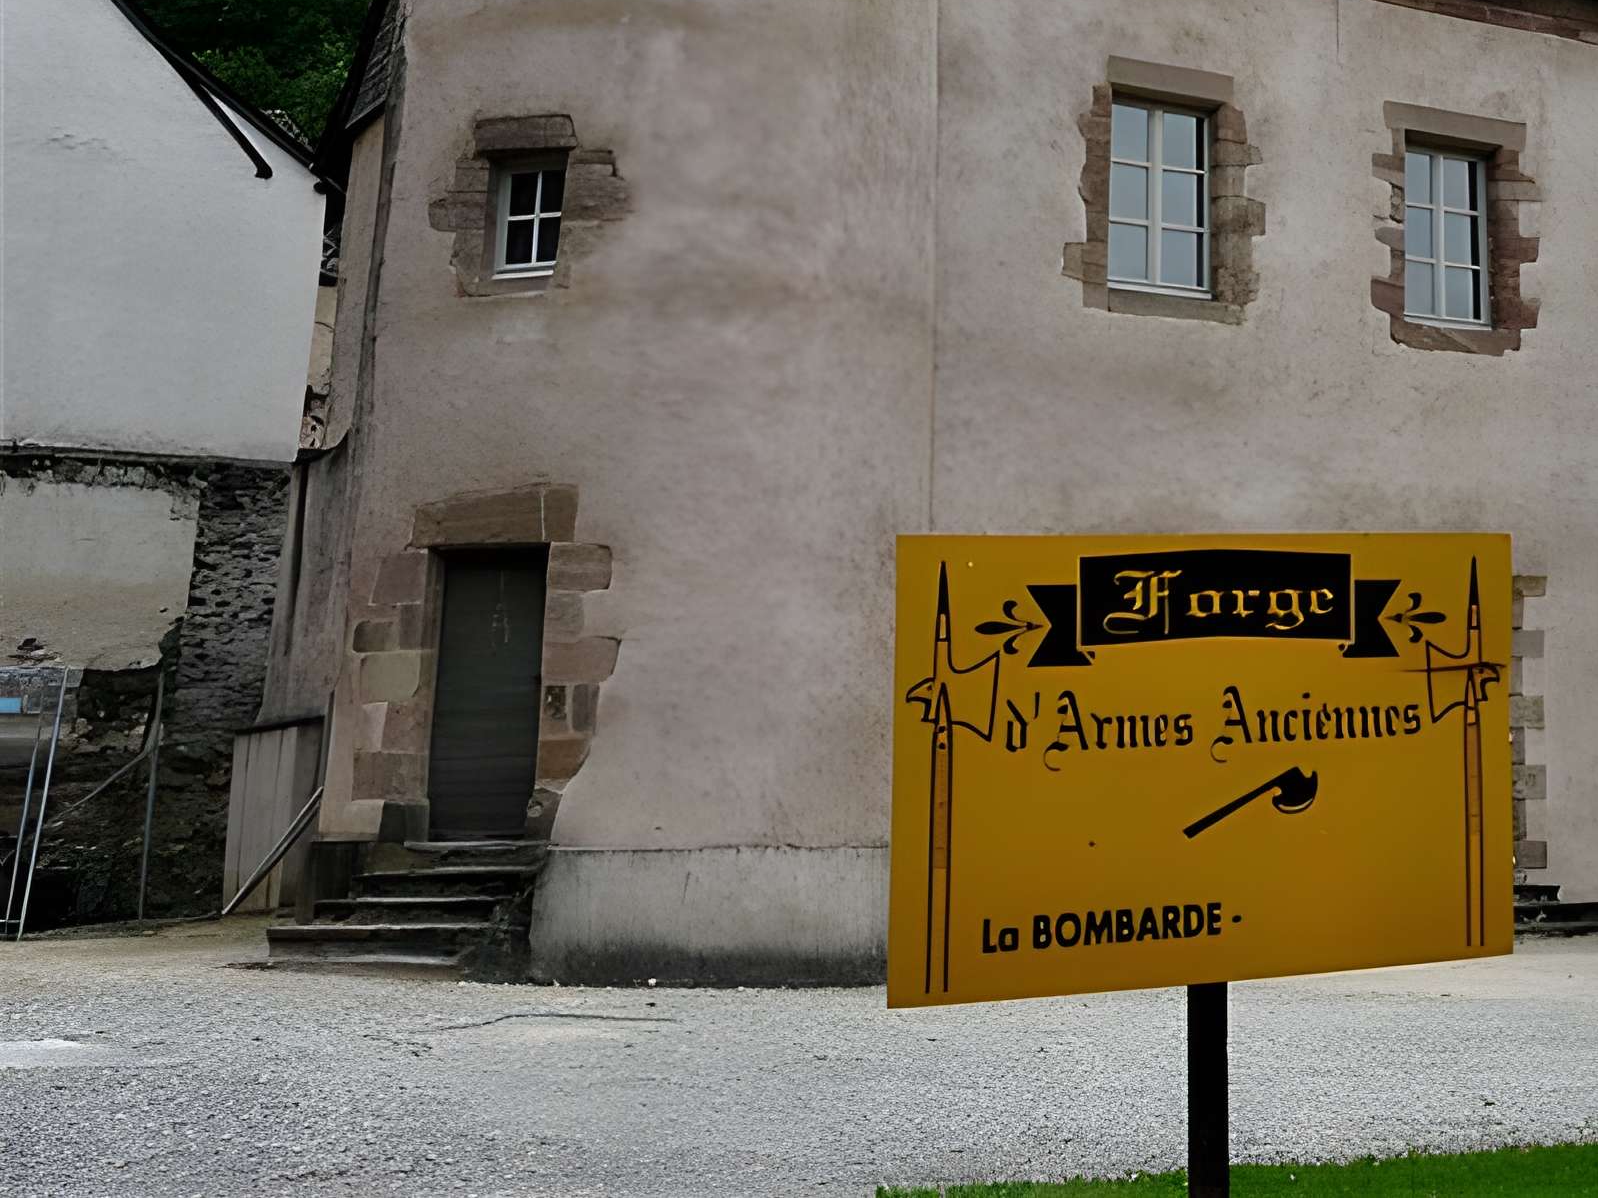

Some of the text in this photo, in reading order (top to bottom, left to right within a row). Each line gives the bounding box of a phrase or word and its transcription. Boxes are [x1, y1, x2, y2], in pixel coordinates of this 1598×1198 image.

[1102, 569, 1335, 635] Forge
[1005, 689, 1194, 773] d'Armes
[982, 902, 1222, 954] La BOMBARDE
